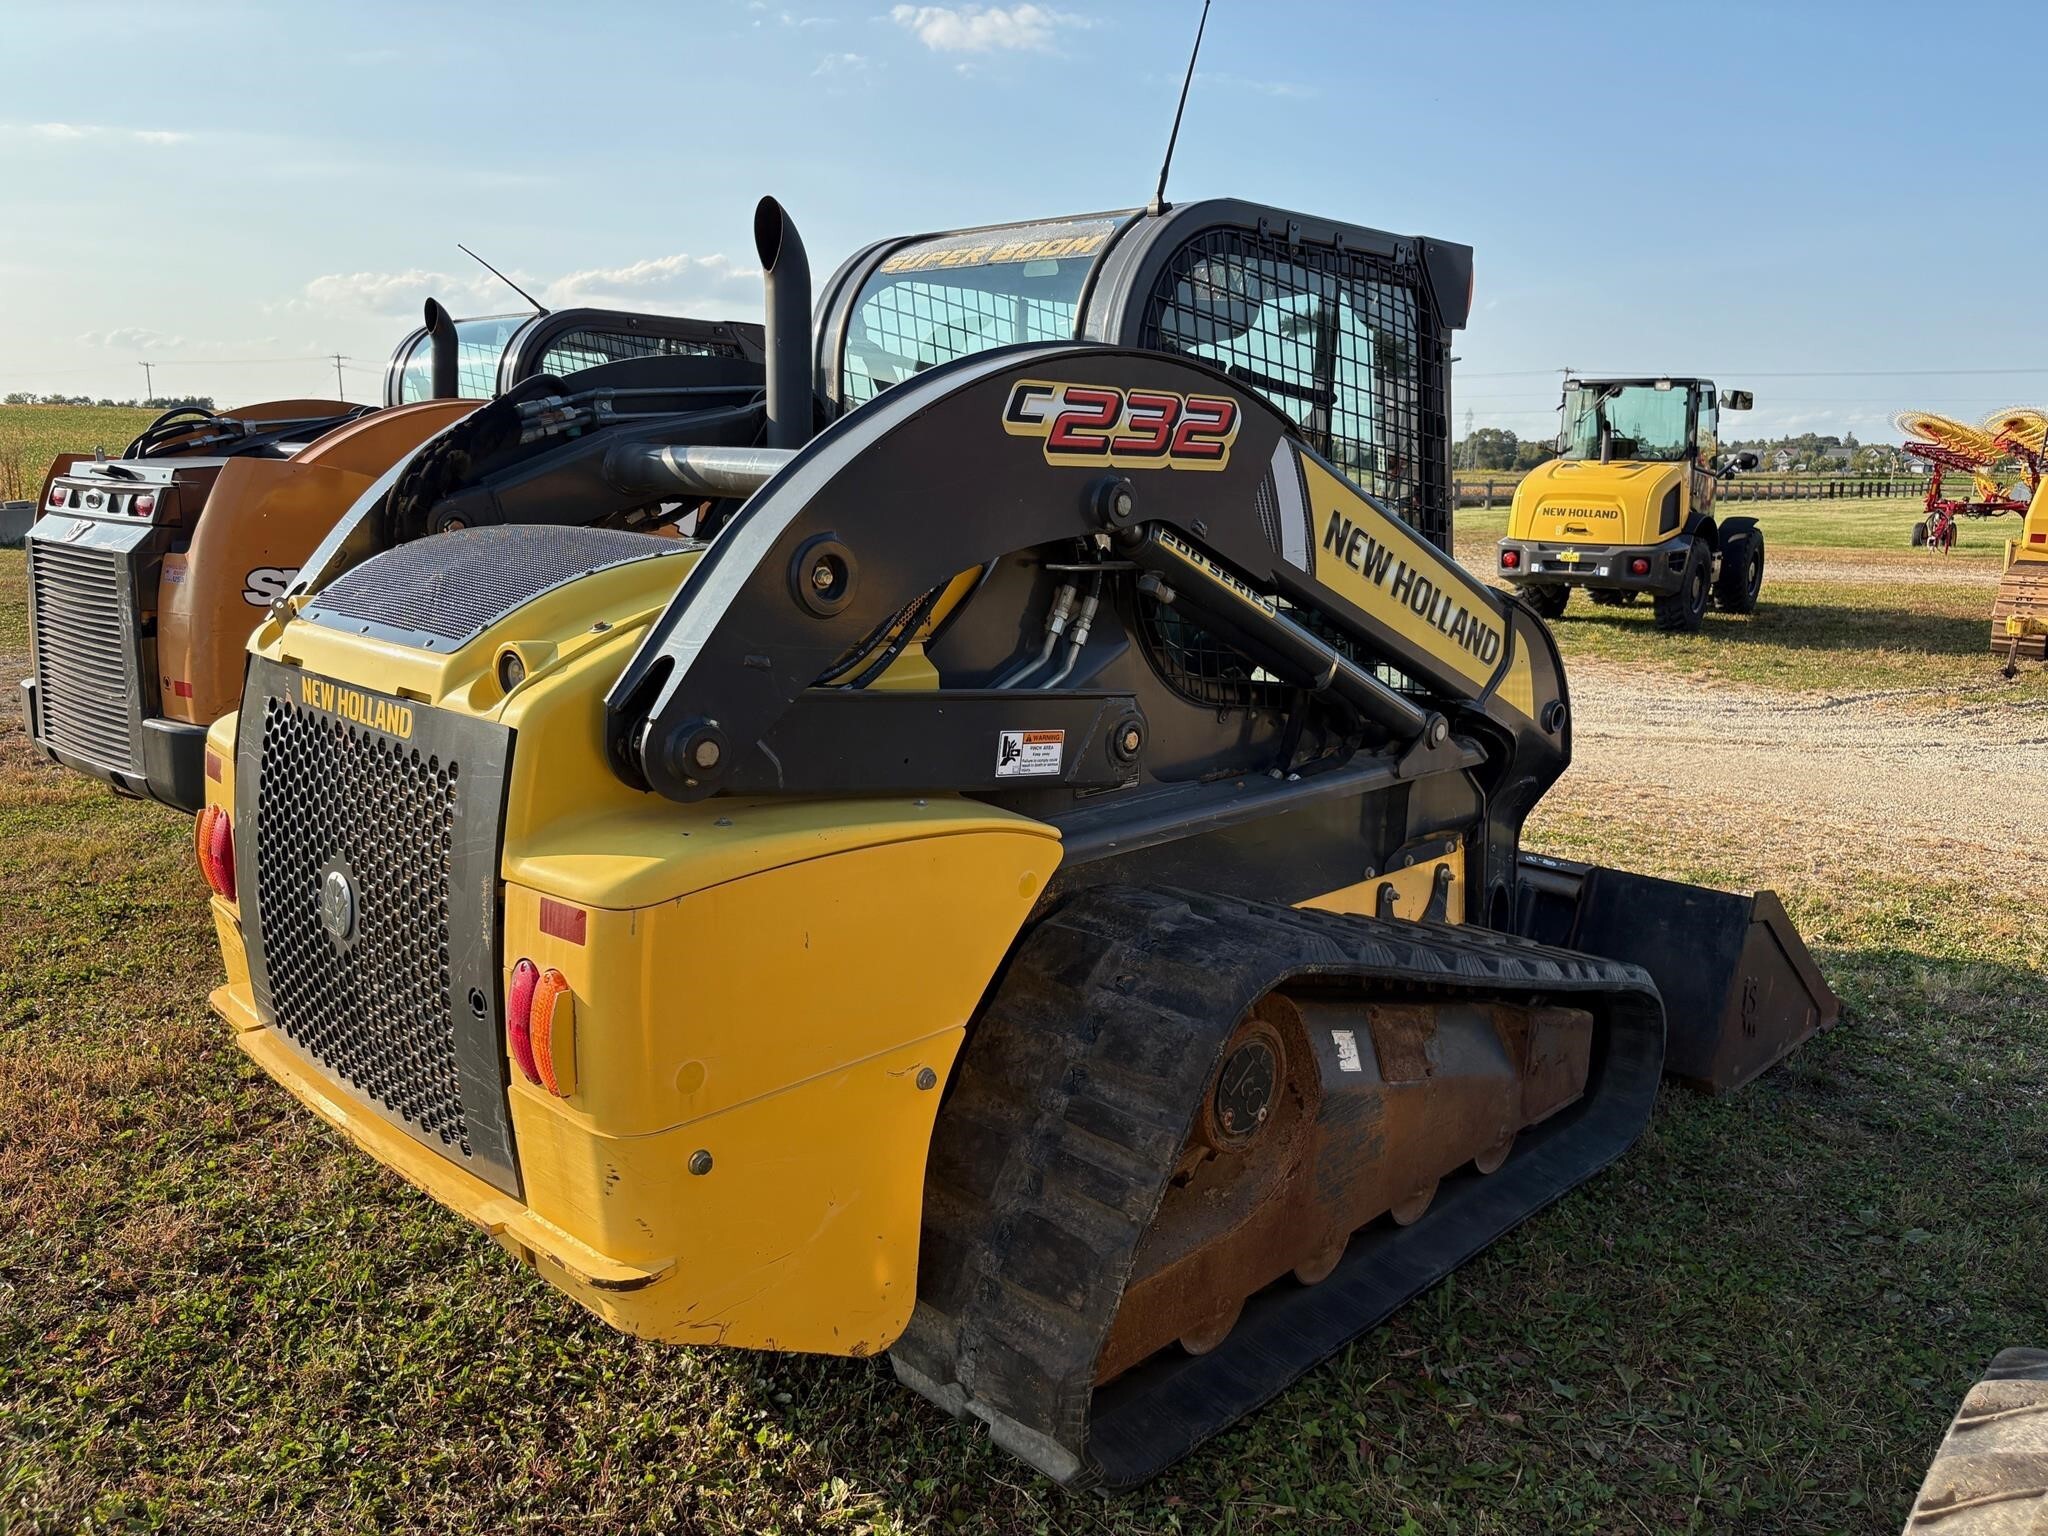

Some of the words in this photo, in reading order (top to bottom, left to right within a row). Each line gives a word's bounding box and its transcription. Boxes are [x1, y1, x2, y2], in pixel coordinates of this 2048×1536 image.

[883, 247, 992, 271] SUPER
[988, 236, 1106, 262] BOOM
[1004, 382, 1239, 466] C232
[1542, 507, 1566, 517] NEW
[1568, 508, 1619, 520] HOLLAND
[1160, 530, 1204, 567] 200
[1207, 560, 1276, 616] SERIES
[1322, 509, 1394, 587] NEW
[1390, 560, 1501, 666] HOLLAND
[301, 676, 335, 713] NEW
[337, 687, 413, 740] HOLLAND
